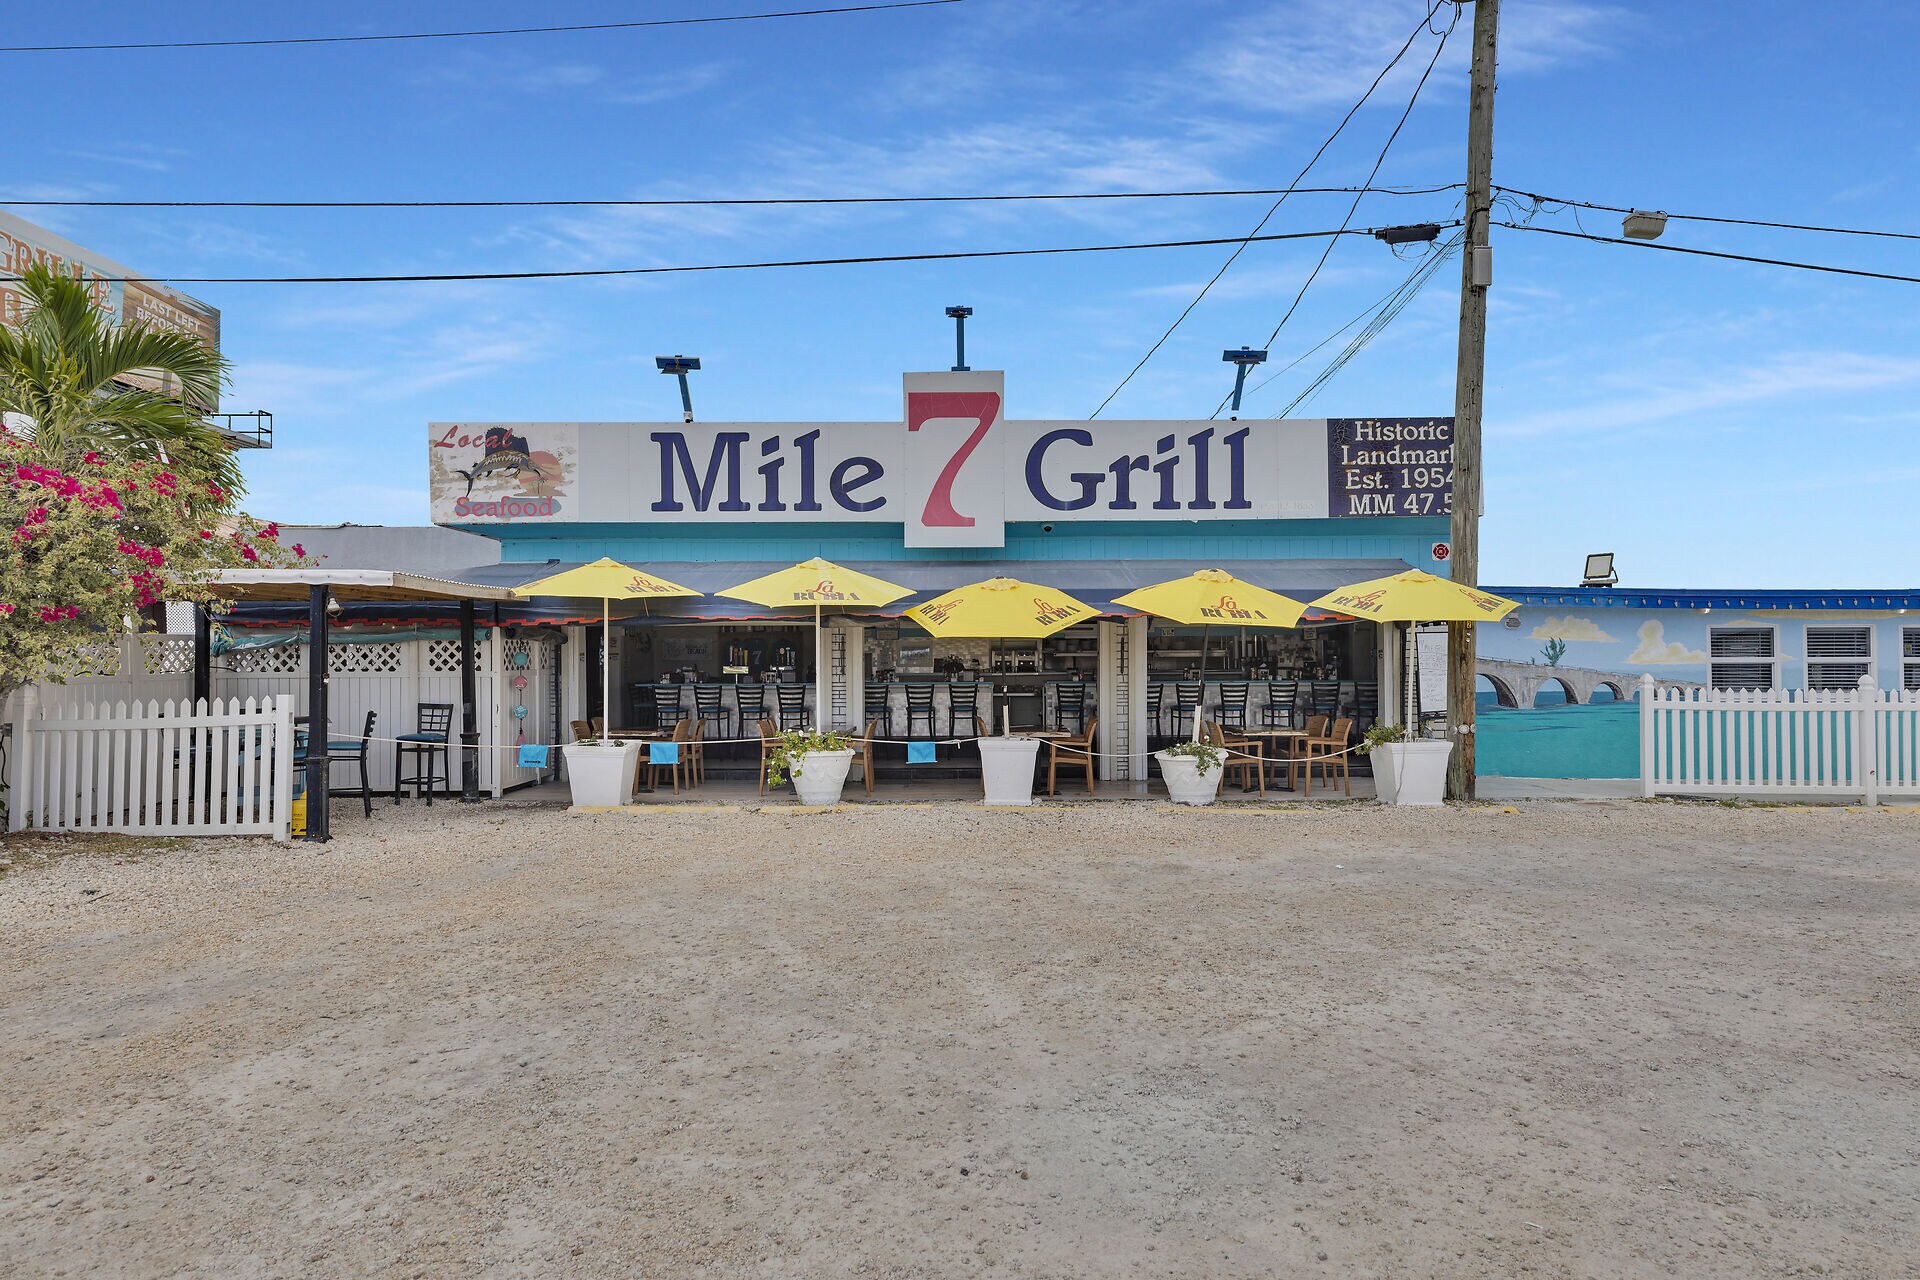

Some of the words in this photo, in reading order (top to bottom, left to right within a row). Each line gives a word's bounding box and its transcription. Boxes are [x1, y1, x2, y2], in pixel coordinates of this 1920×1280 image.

[142, 295, 172, 318] LAST
[175, 311, 201, 332] LEFT
[434, 424, 514, 449] Local
[1354, 420, 1449, 442] Historic
[651, 428, 887, 512] Mile
[907, 392, 1001, 528] 7
[1025, 427, 1252, 511] Grill
[1341, 445, 1454, 466] Landmar
[1345, 467, 1389, 490] Est.
[455, 495, 554, 517] Seafood
[1349, 493, 1396, 515] MM
[1403, 492, 1453, 514] 47.5
[806, 580, 841, 597] La
[1034, 604, 1081, 626] RUBIA
[1200, 607, 1268, 620] RUBIA
[1211, 595, 1246, 613] La
[1332, 596, 1384, 613] RUBIA
